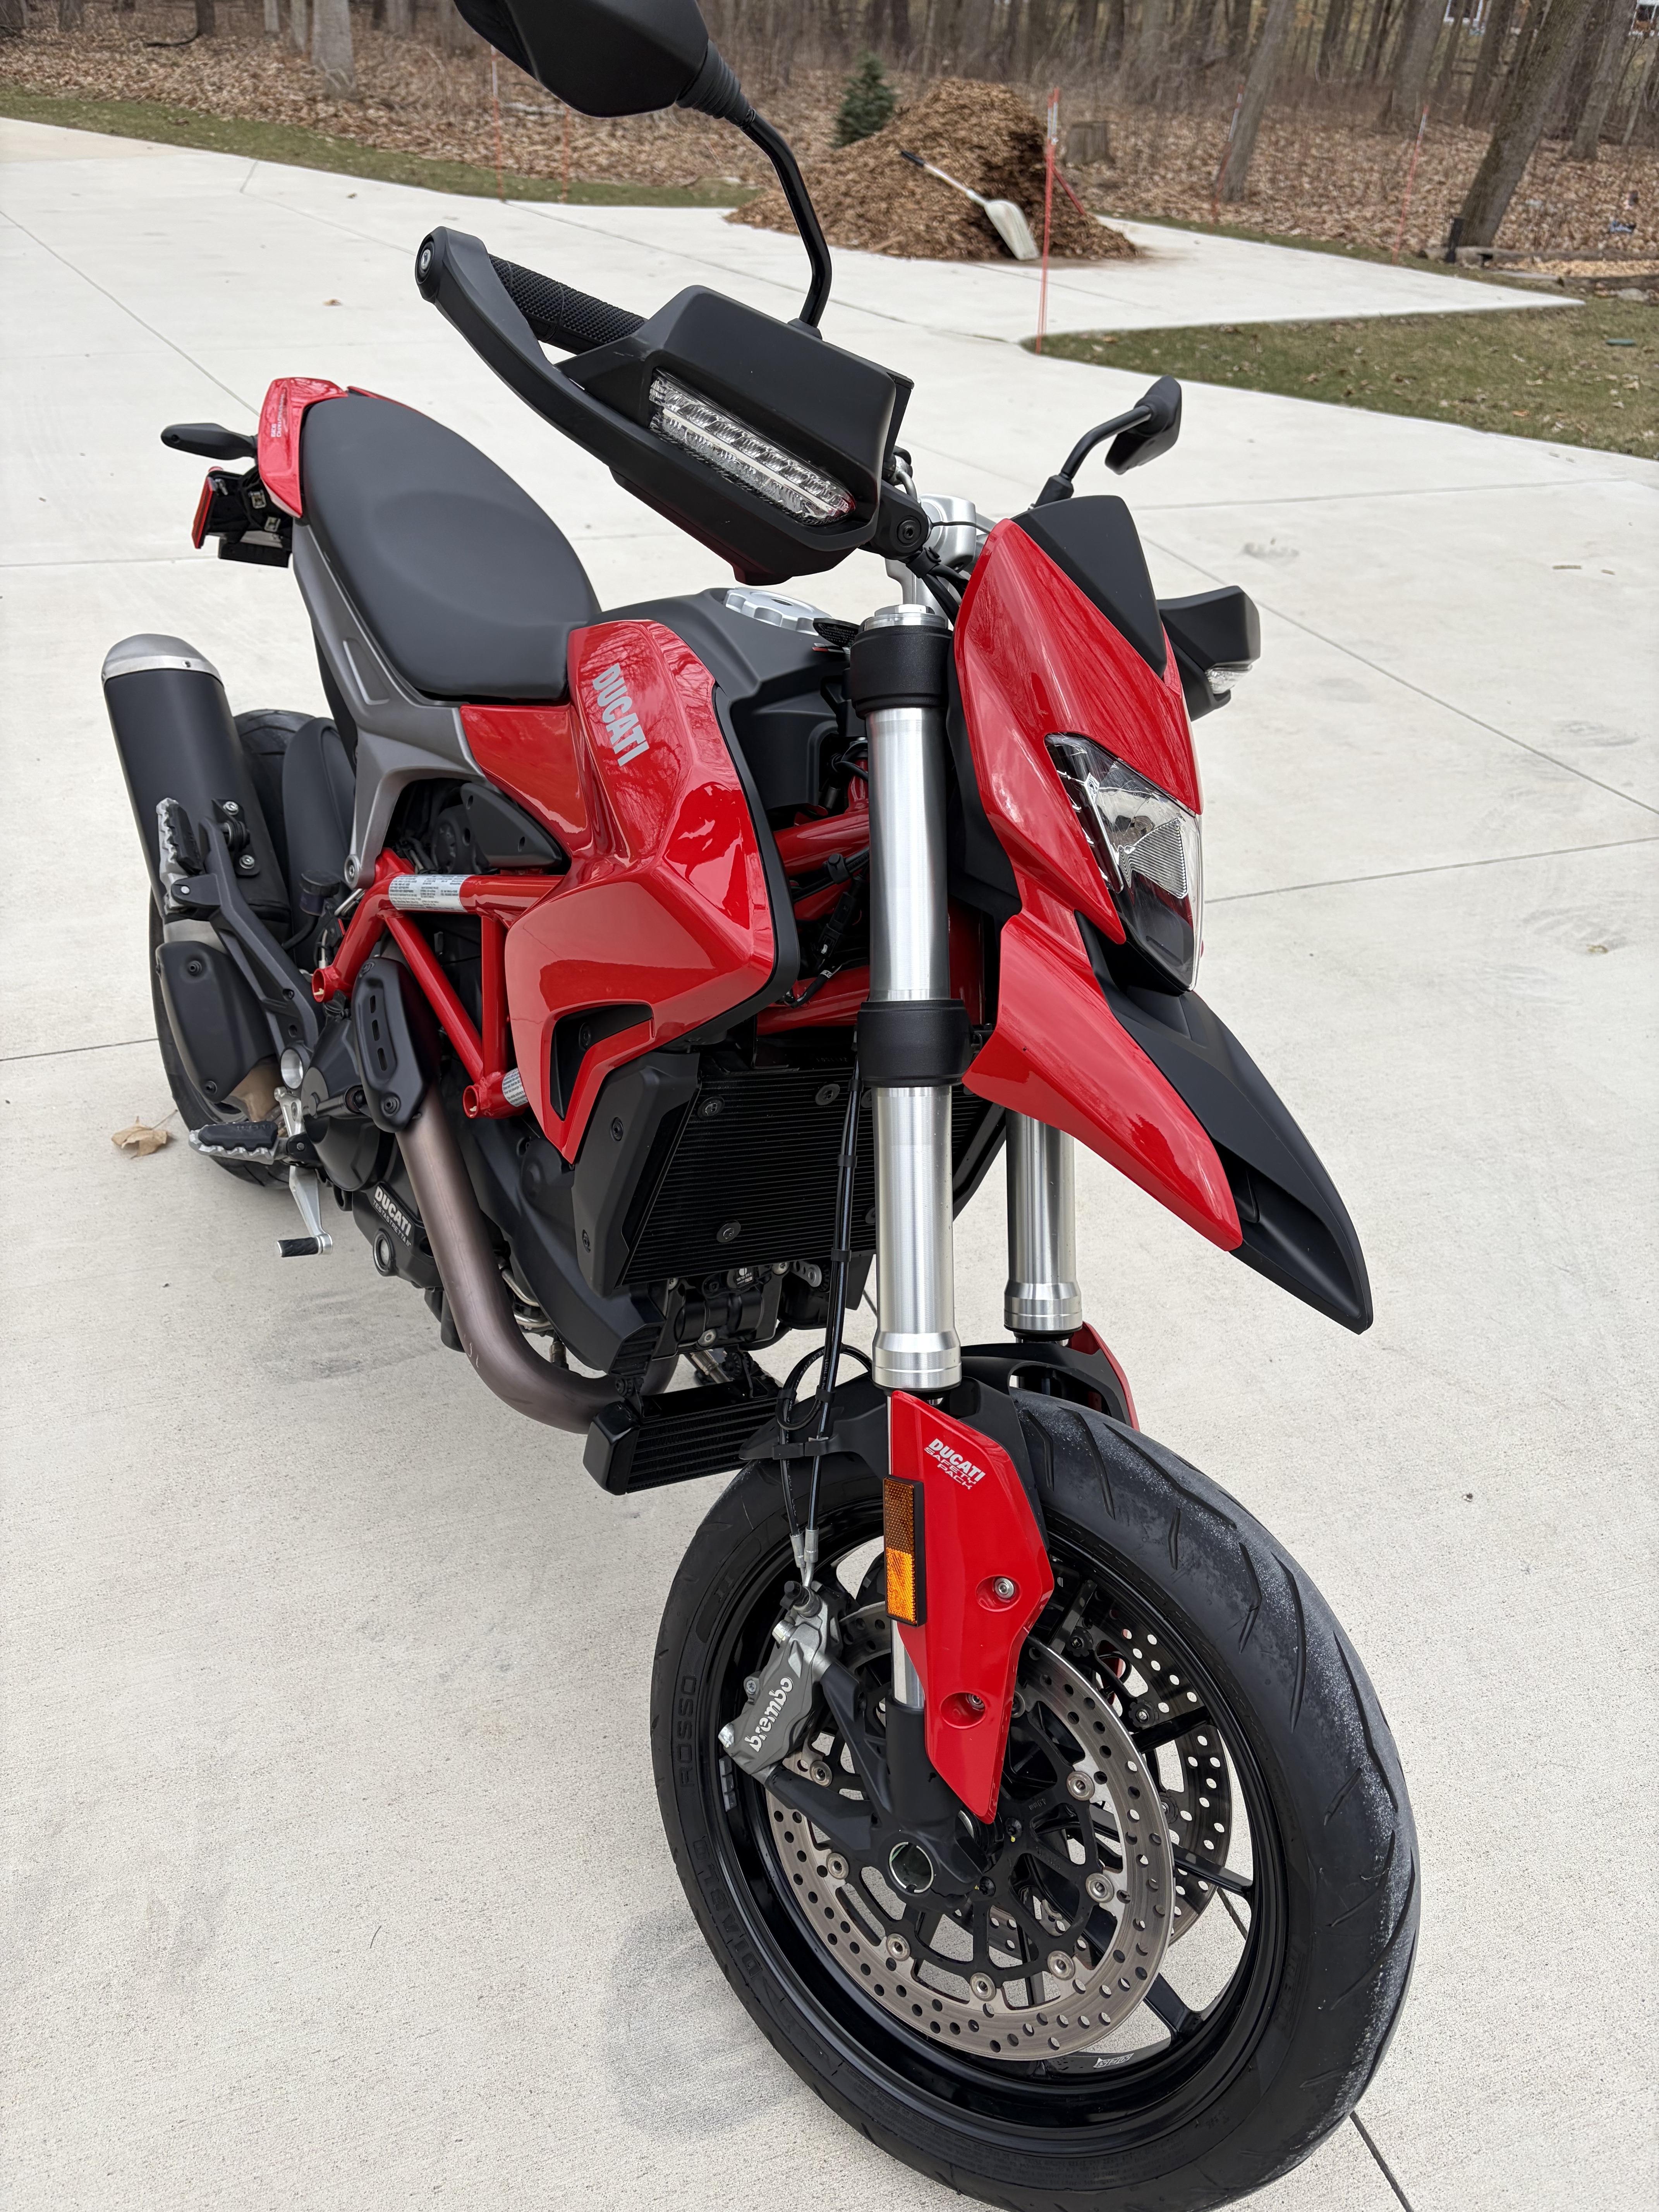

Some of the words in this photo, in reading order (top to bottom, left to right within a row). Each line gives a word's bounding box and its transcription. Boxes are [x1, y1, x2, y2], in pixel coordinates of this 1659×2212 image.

[592, 663, 649, 767] DUCATI
[373, 1199, 406, 1243] TESTASTRETTA
[374, 1185, 412, 1236] DUCATI
[924, 1447, 977, 1484] SAFETY
[928, 1438, 986, 1482] DUCATI
[937, 1463, 972, 1490] PACK
[676, 1675, 697, 1788] ROSSO
[745, 1676, 793, 1752] brembo
